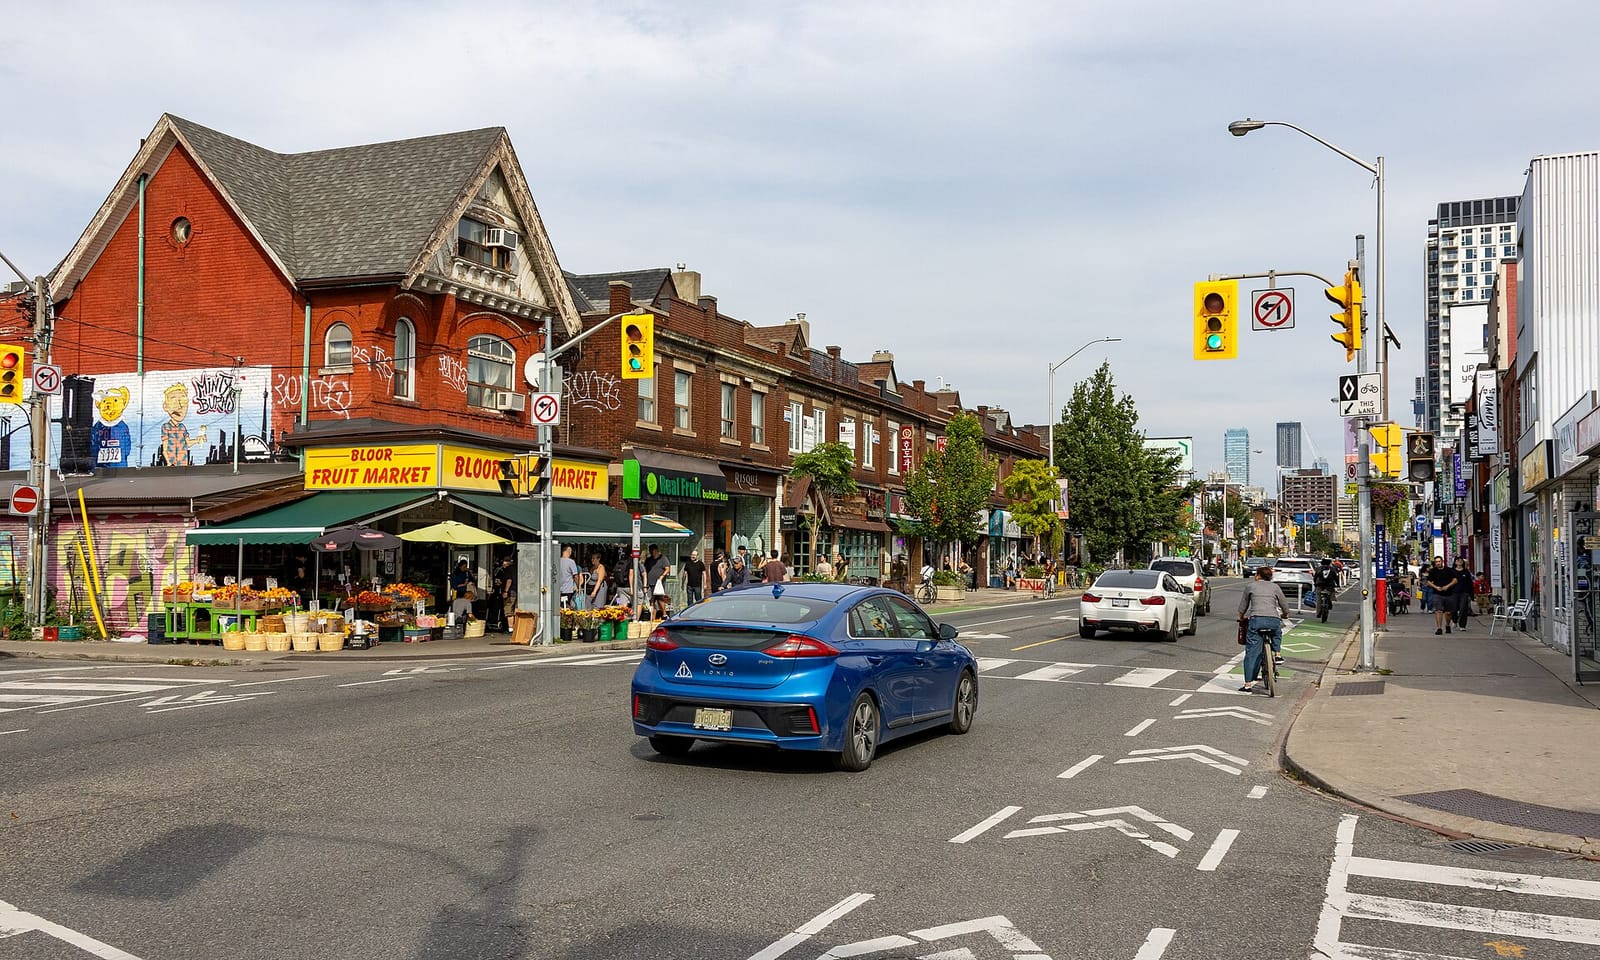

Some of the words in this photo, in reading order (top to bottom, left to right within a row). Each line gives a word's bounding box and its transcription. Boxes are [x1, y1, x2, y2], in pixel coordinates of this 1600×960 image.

[351, 447, 393, 462] BLOOR
[312, 468, 359, 485] FRUIT
[362, 465, 431, 484] MARKET
[456, 456, 500, 480] BLOOR
[551, 466, 597, 490] MARKET
[659, 475, 680, 496] Real
[680, 476, 702, 498] Fruit
[702, 489, 720, 499] bubble
